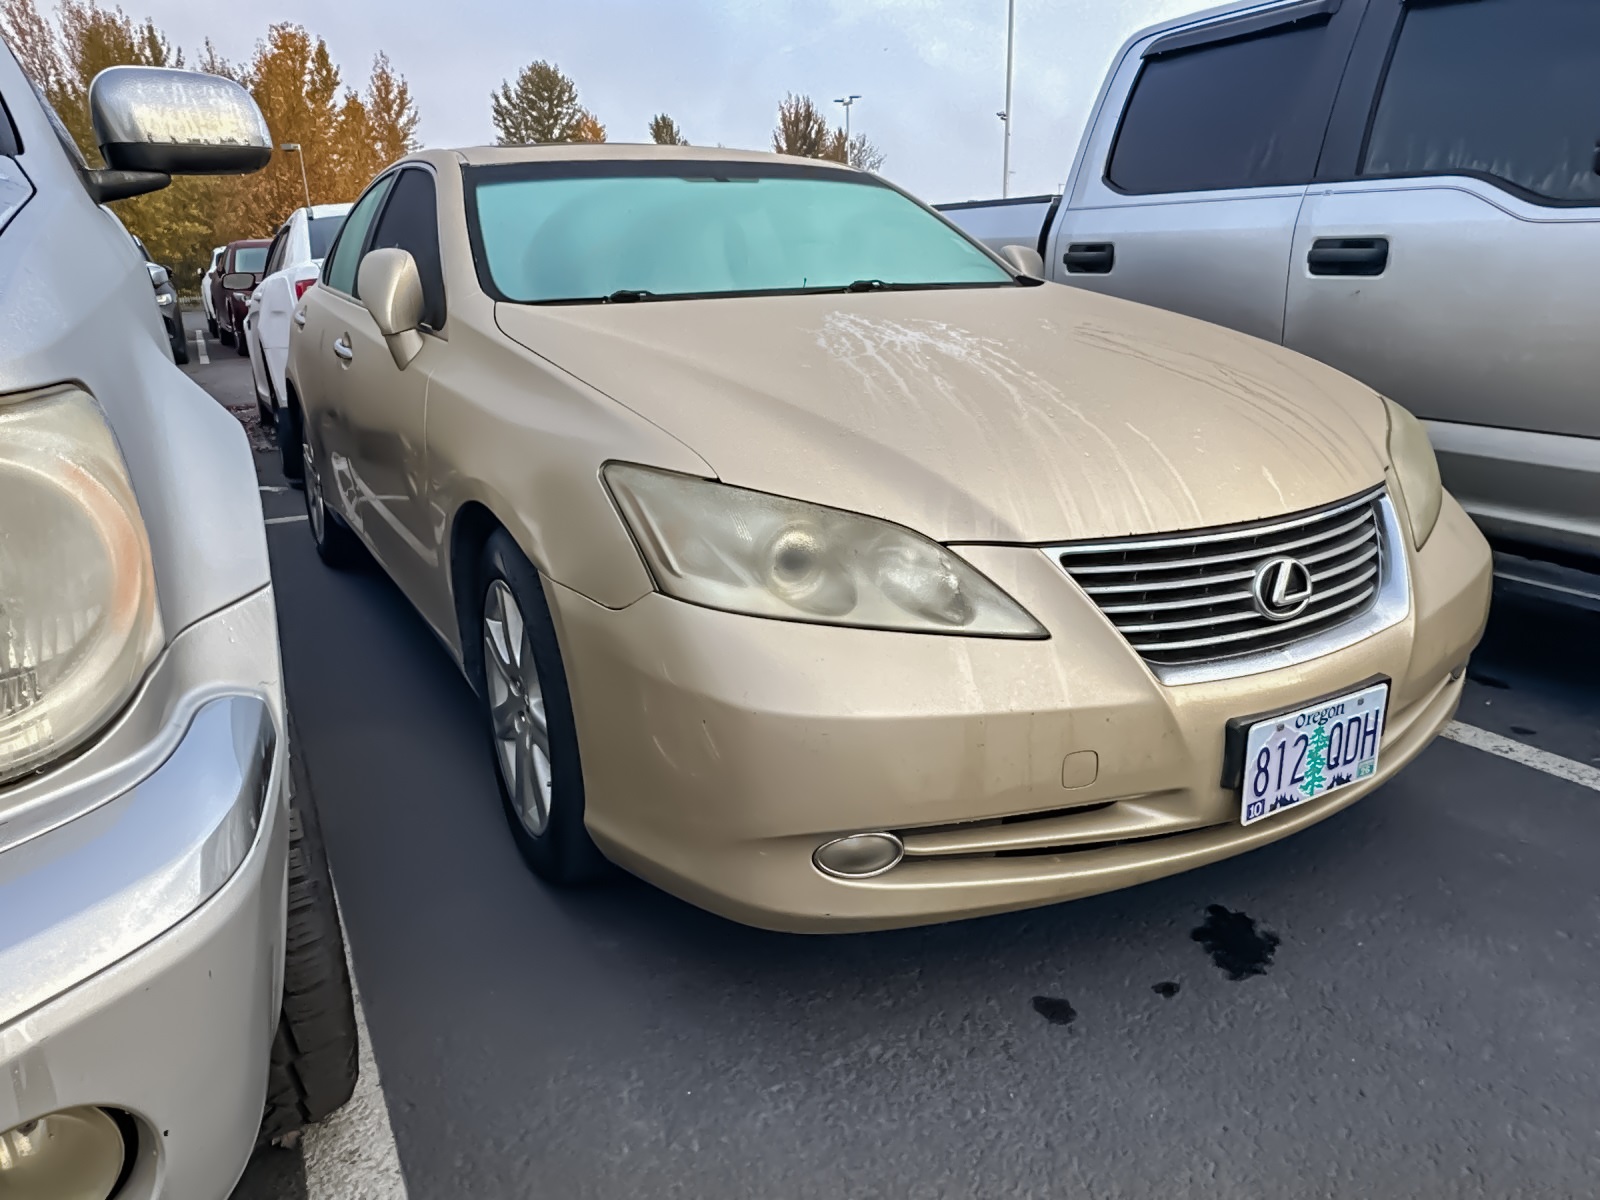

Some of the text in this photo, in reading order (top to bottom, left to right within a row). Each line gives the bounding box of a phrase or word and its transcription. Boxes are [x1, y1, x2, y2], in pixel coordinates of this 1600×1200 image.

[1295, 703, 1345, 729] Oregon
[1253, 709, 1380, 798] 812 QDH
[1248, 802, 1263, 818] 10
